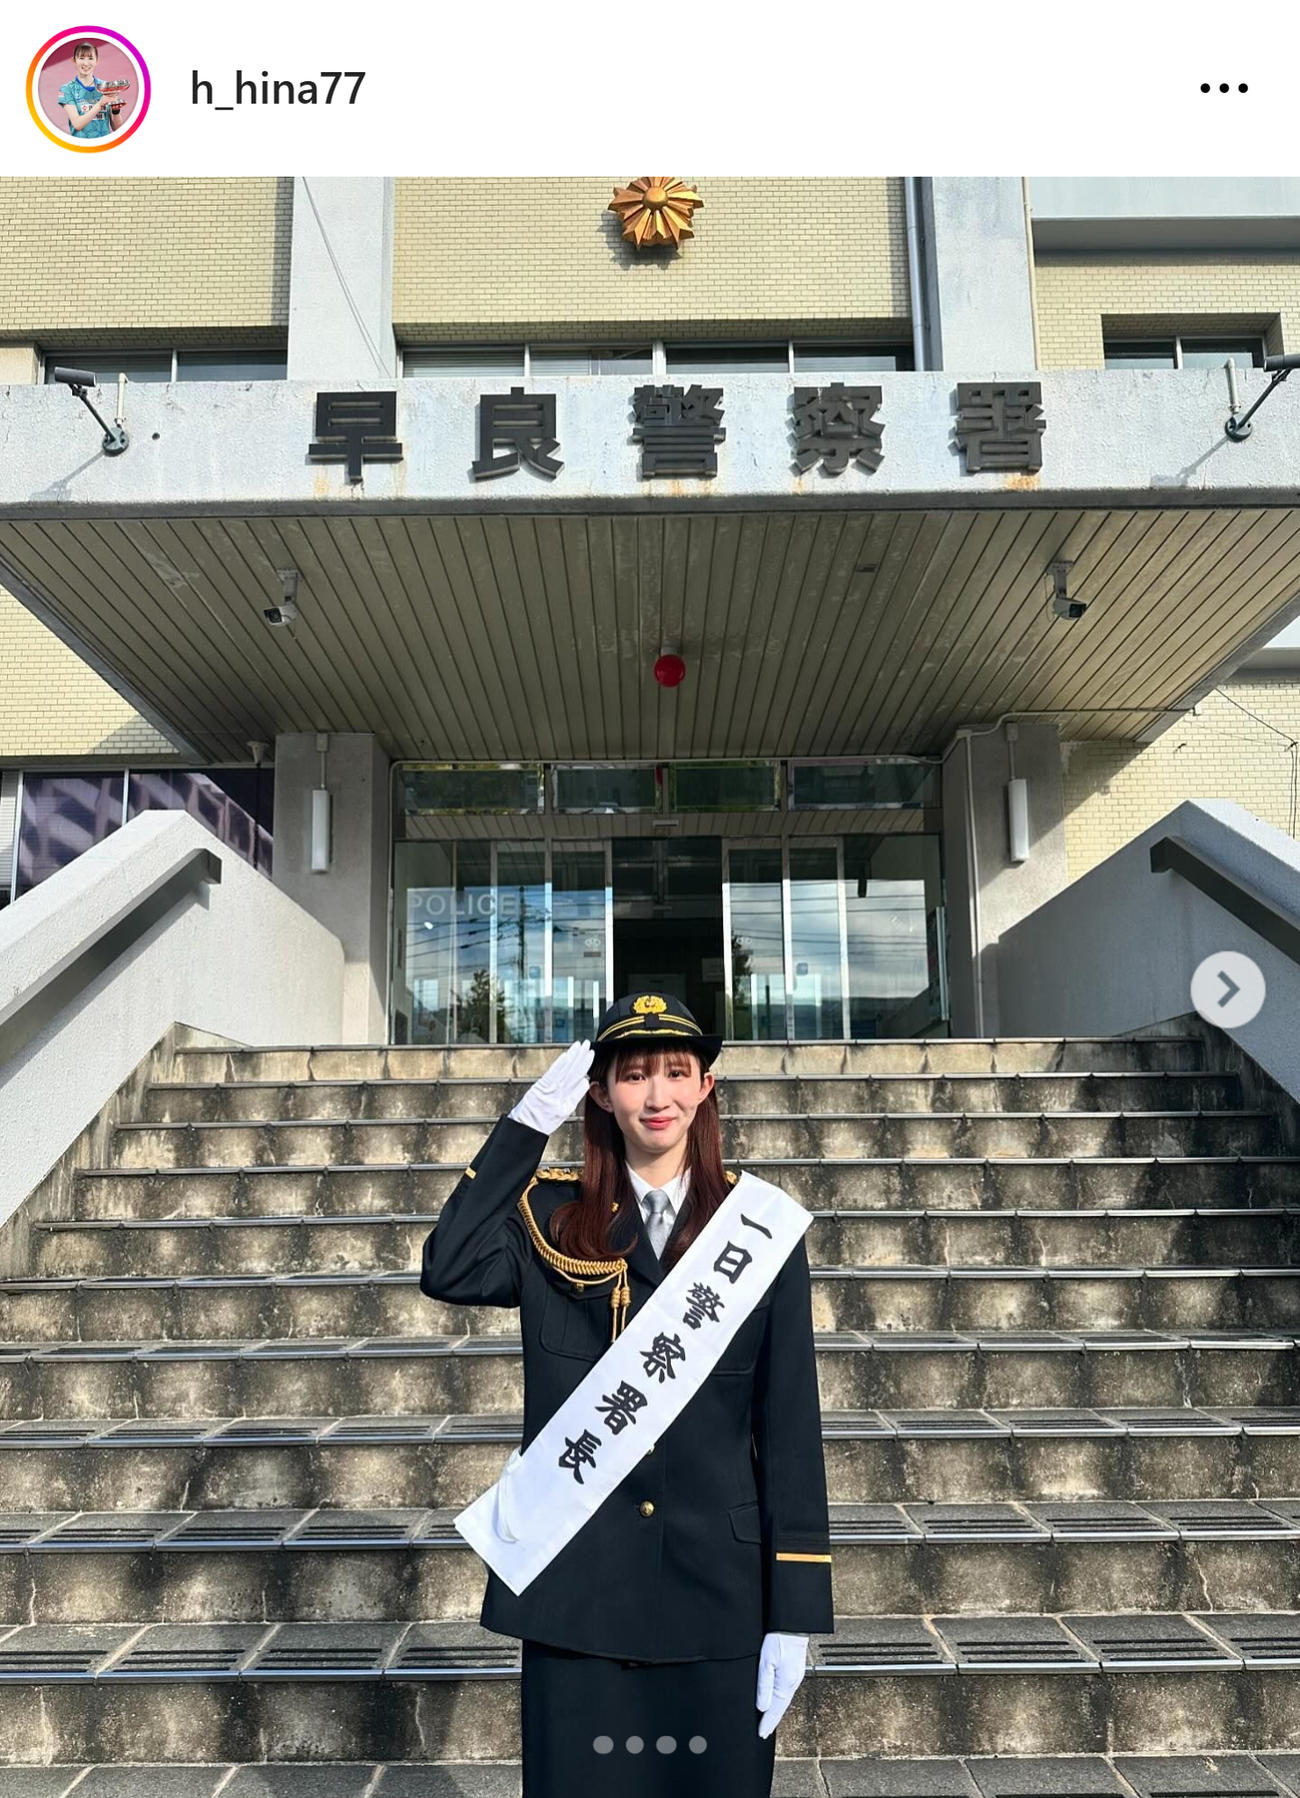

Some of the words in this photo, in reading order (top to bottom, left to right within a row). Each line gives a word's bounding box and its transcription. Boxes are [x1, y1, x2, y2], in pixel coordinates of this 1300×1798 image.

[309, 383, 1047, 485] 早良警察署
[409, 894, 516, 916] POLICE
[558, 1213, 773, 1485] 一日警察署長
